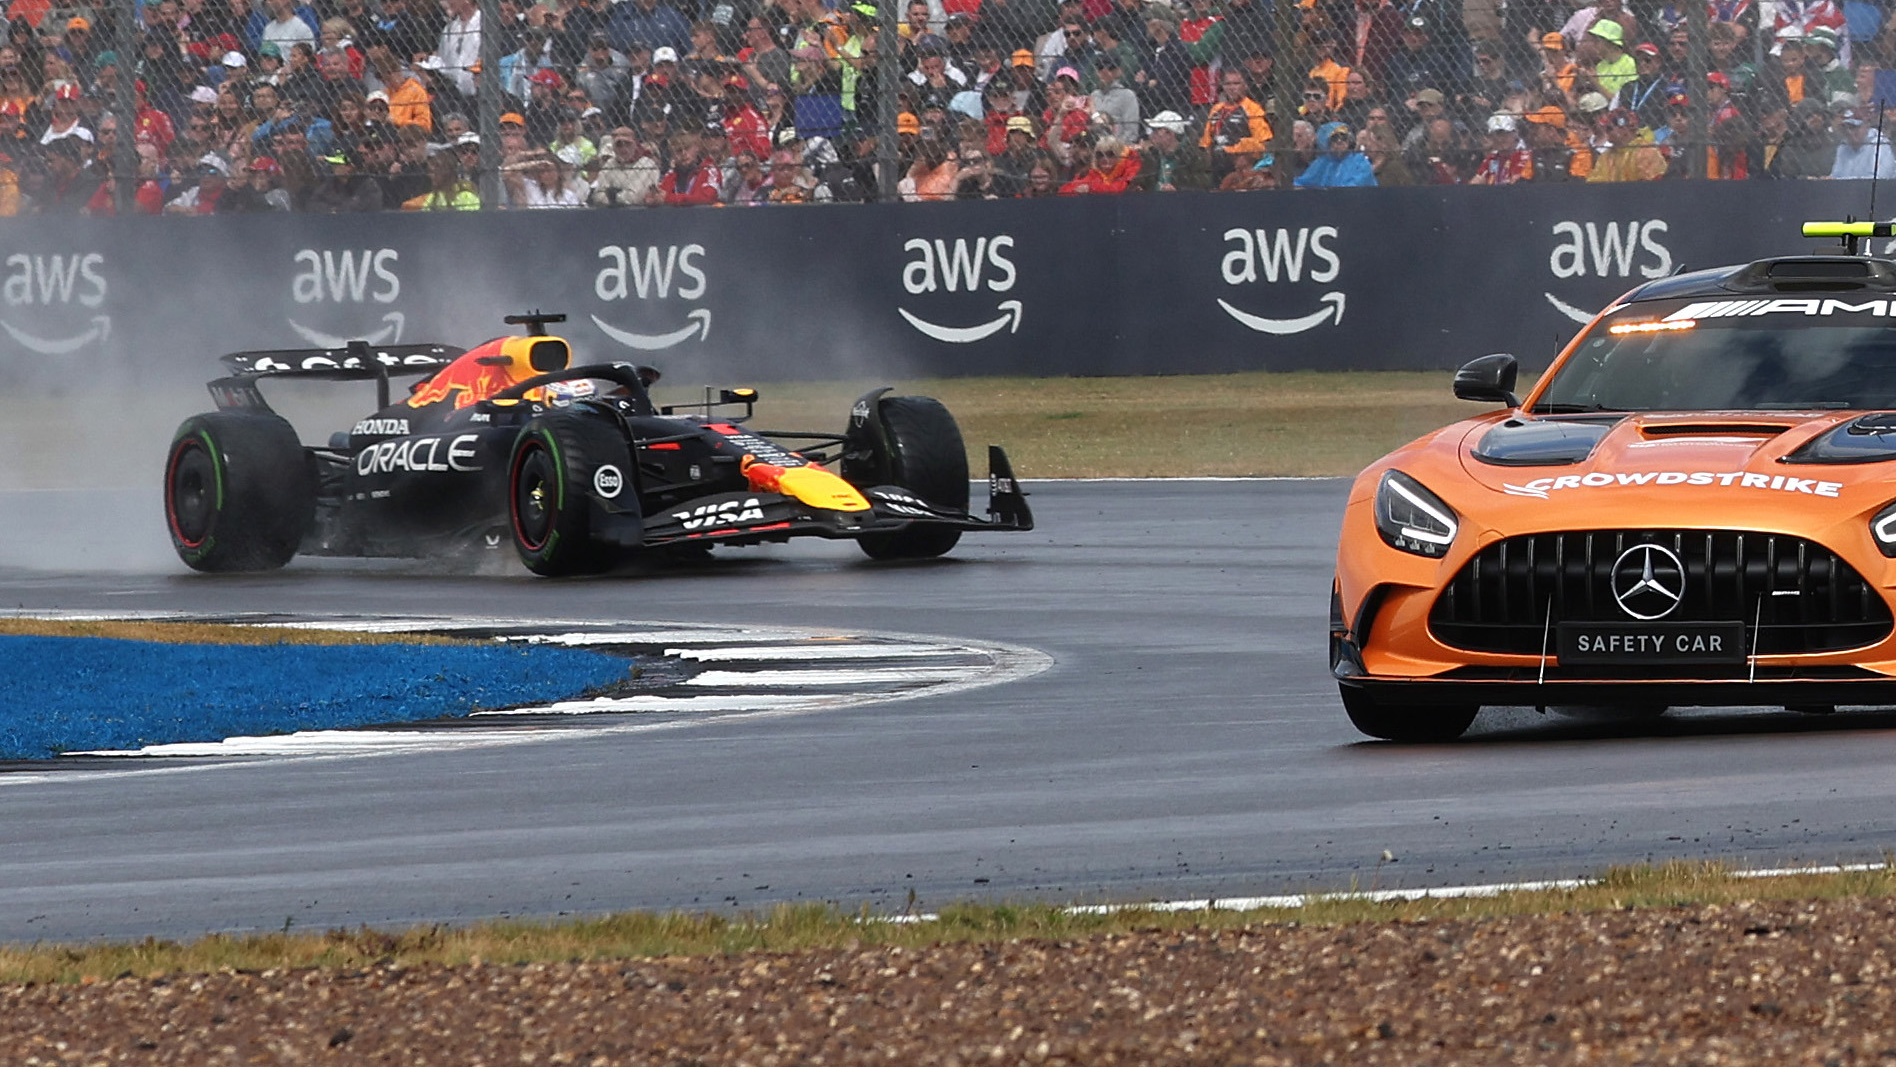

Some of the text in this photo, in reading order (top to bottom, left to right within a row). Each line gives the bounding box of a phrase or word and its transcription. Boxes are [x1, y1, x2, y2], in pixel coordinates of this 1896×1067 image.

[292, 248, 400, 304] aws
[595, 243, 706, 300] aws
[902, 235, 1017, 294] aws
[1221, 226, 1340, 285] aws
[1550, 219, 1671, 279] aws
[4, 253, 107, 307] aws
[351, 419, 411, 435] HONDA
[357, 435, 483, 476] ORACLE
[1527, 472, 1843, 498] CROWDSTRIKE
[672, 498, 765, 529] VISA
[1577, 635, 1722, 653] SAFETY CAR
